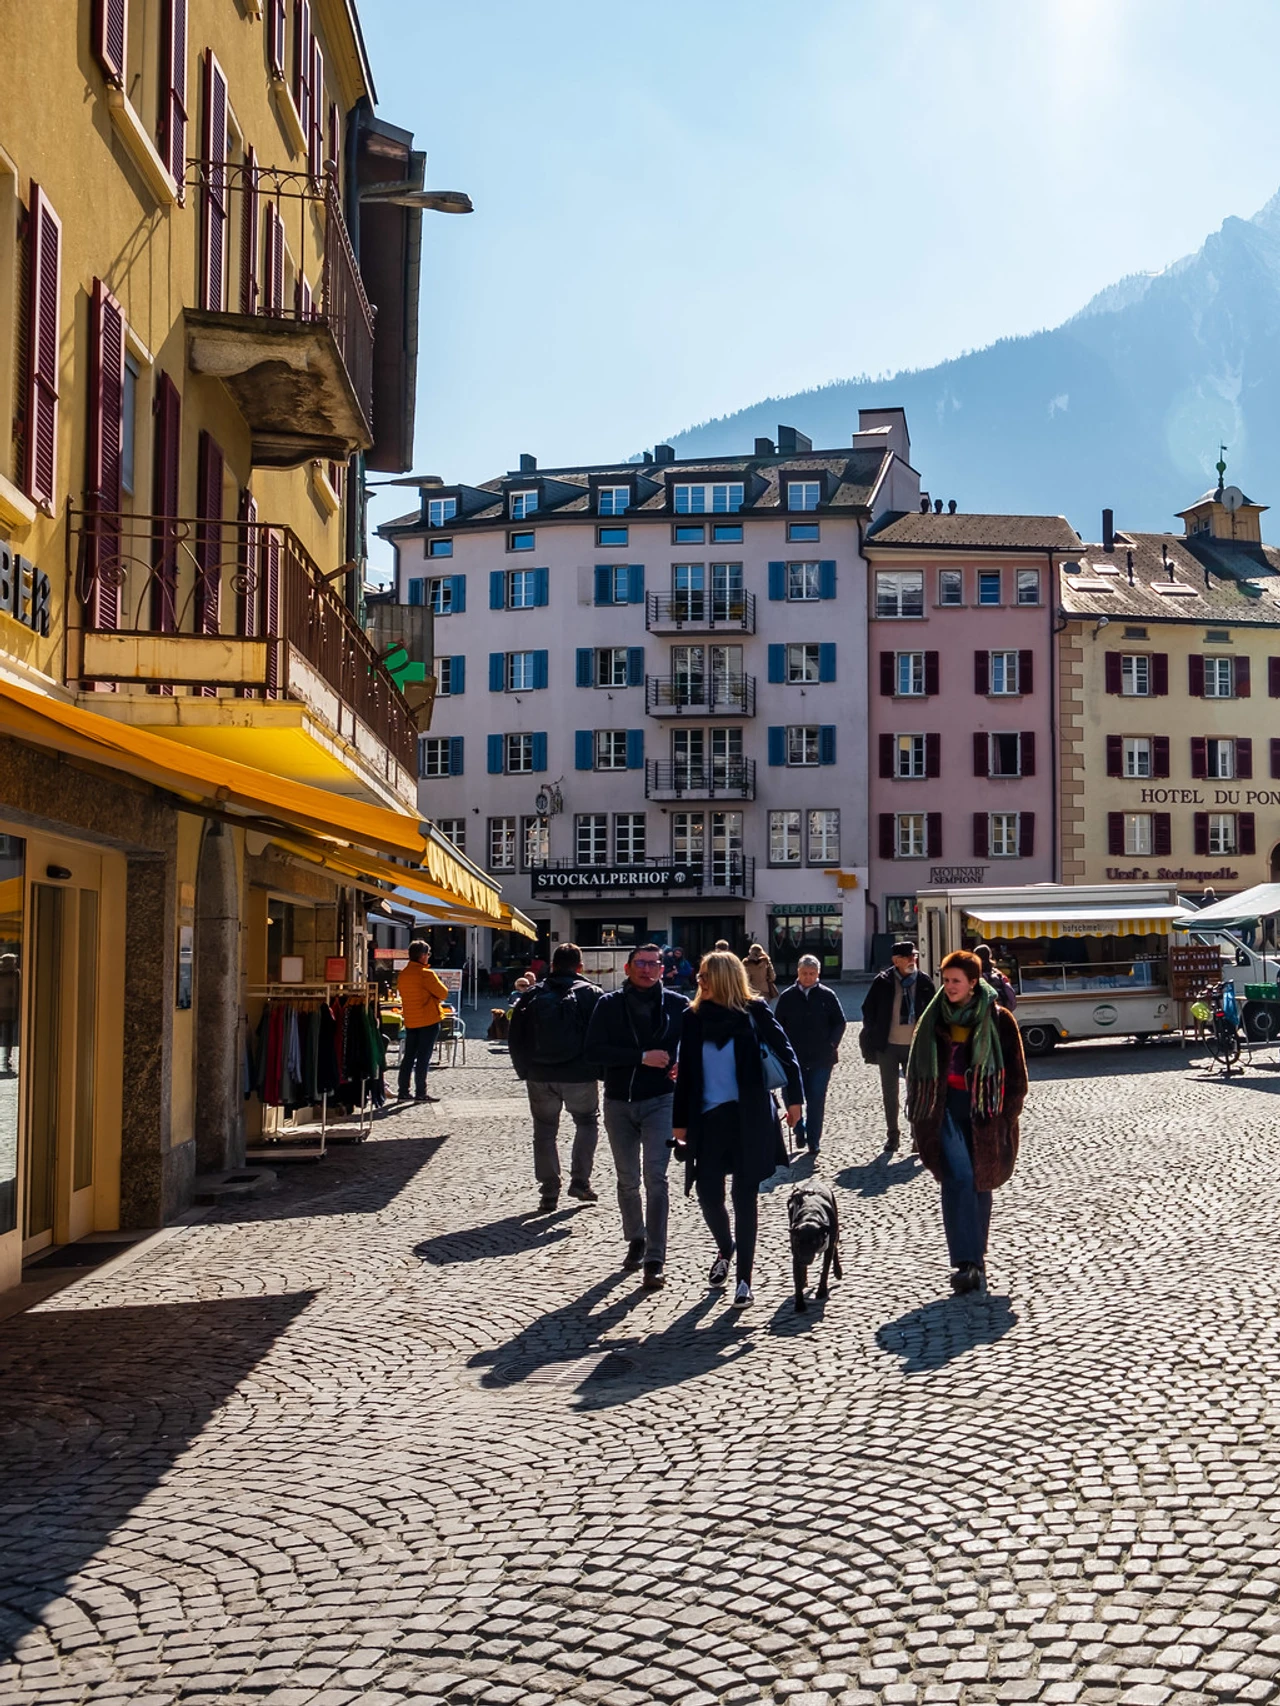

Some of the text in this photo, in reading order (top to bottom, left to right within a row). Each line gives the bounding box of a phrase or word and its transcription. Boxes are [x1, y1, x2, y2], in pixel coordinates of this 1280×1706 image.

[1141, 788, 1204, 804] HOTEL
[1215, 790, 1240, 804] DU
[538, 871, 669, 886] STOCKALPERHOF
[772, 904, 836, 914] GELATERIA
